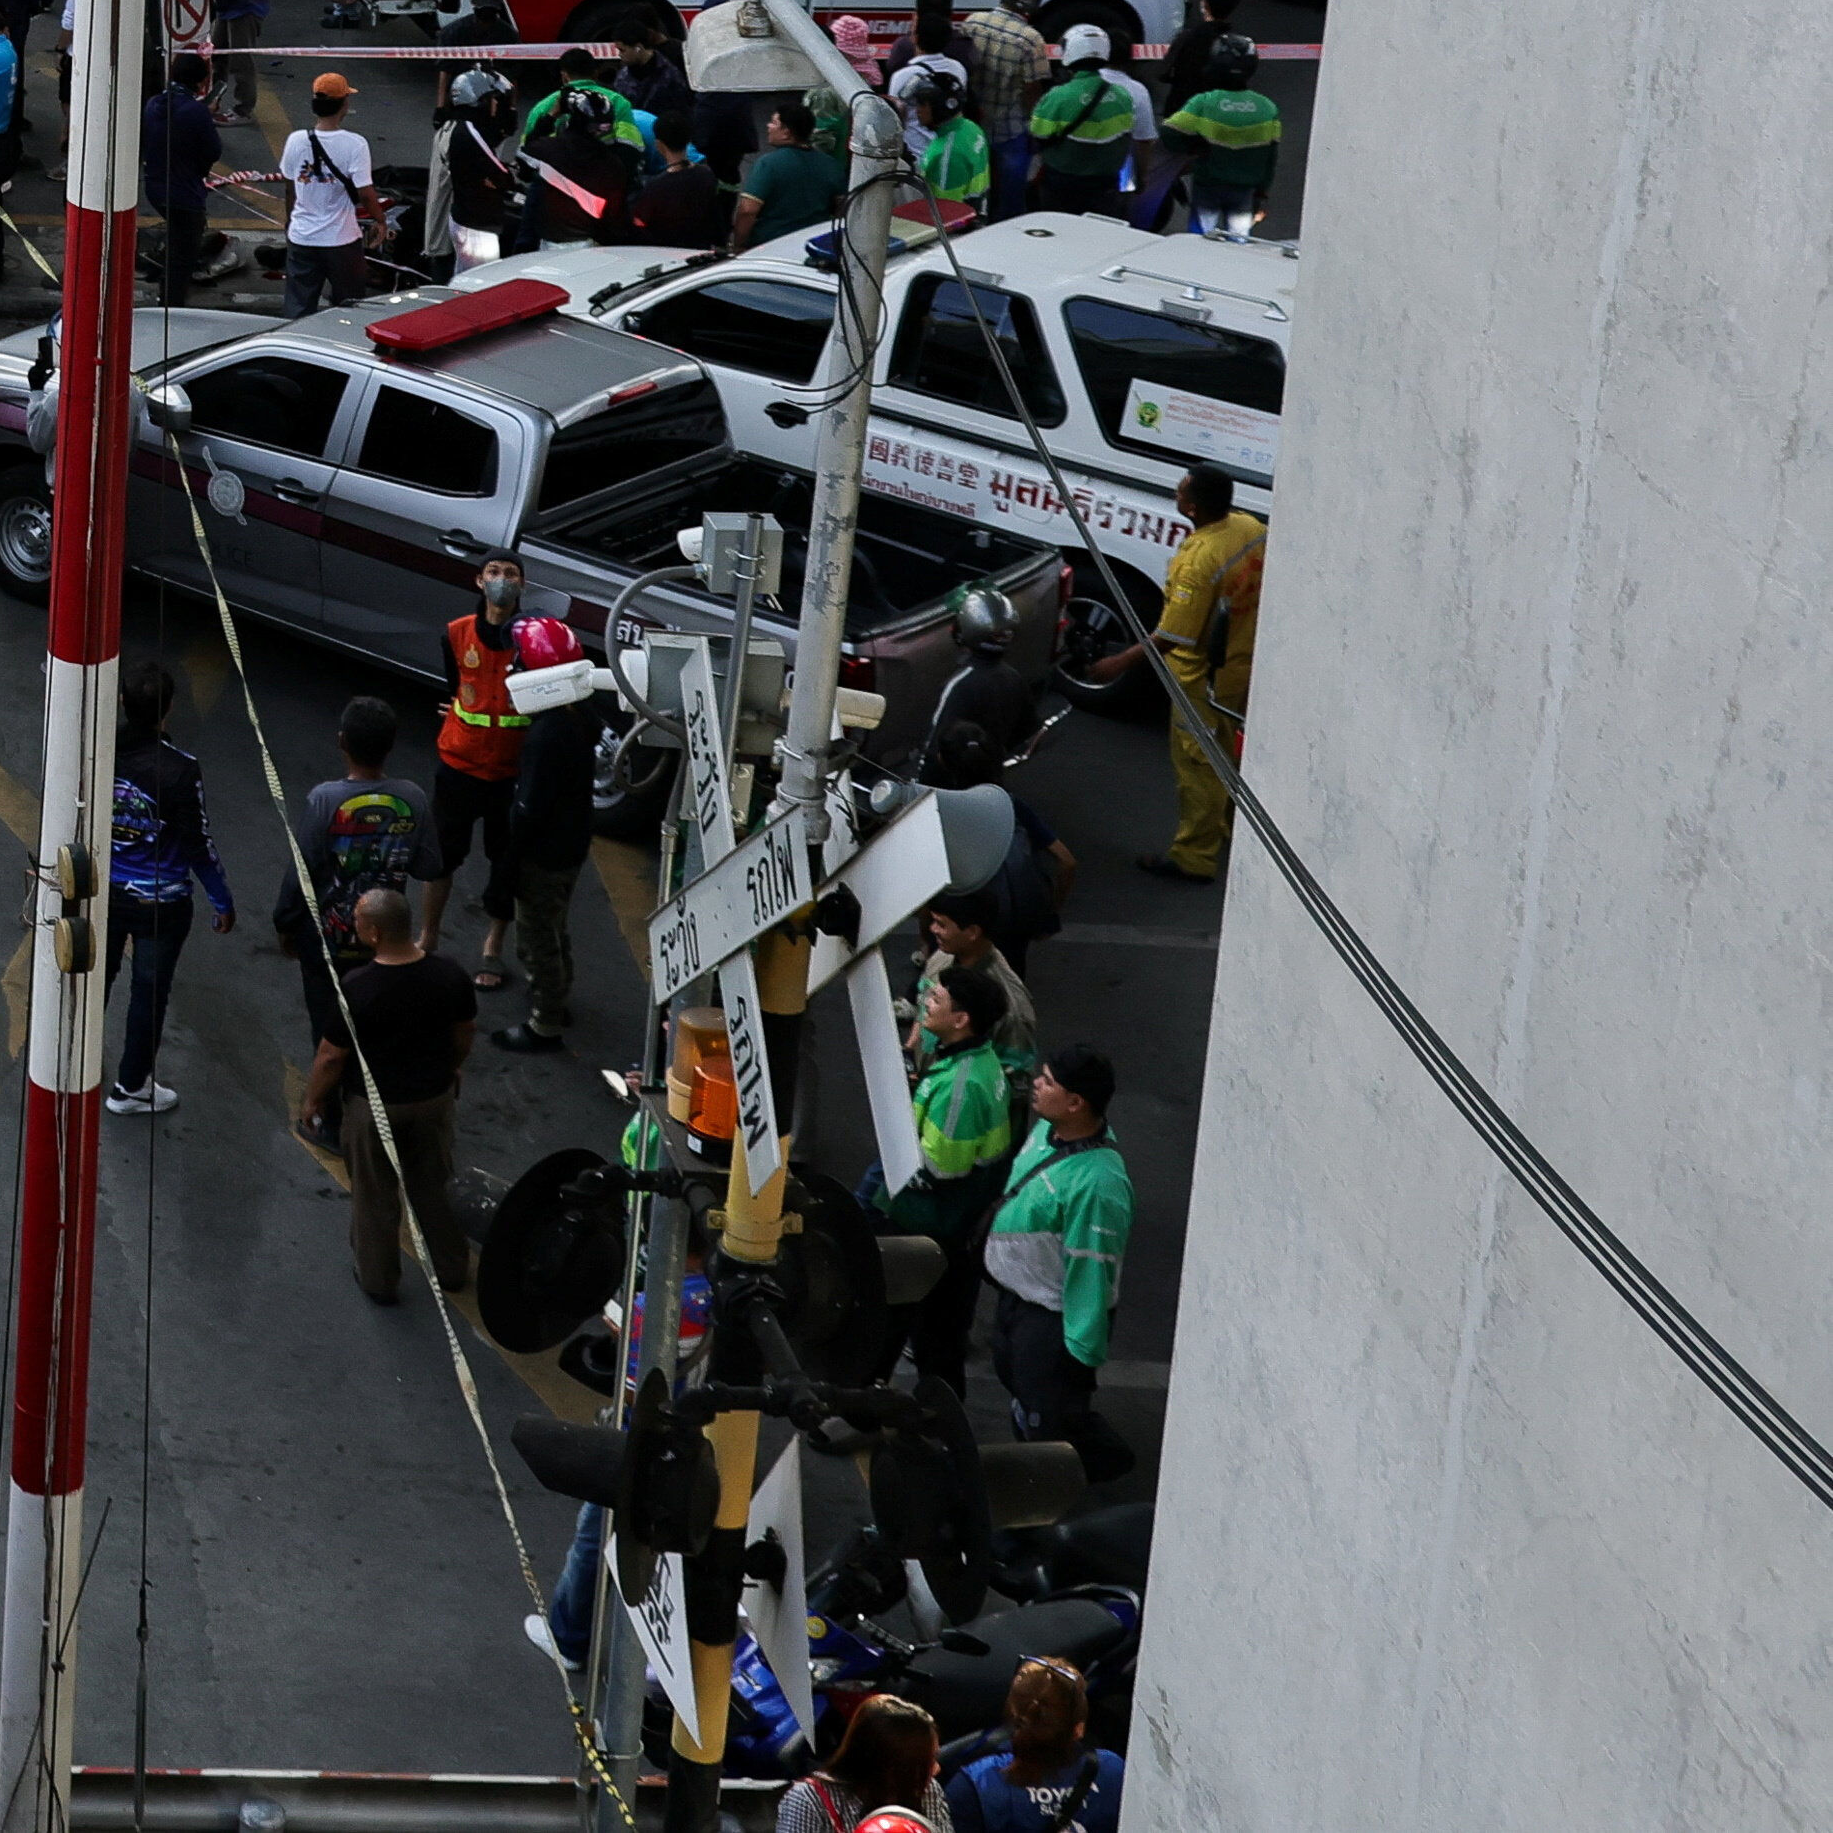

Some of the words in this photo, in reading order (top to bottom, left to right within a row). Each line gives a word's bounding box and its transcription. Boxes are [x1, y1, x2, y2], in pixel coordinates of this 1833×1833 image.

[1219, 99, 1257, 113] Grab
[686, 689, 717, 836] ระวัง
[659, 896, 703, 987] ระวัง
[746, 818, 796, 923] รถไฟ
[728, 996, 768, 1150] รถไฟ
